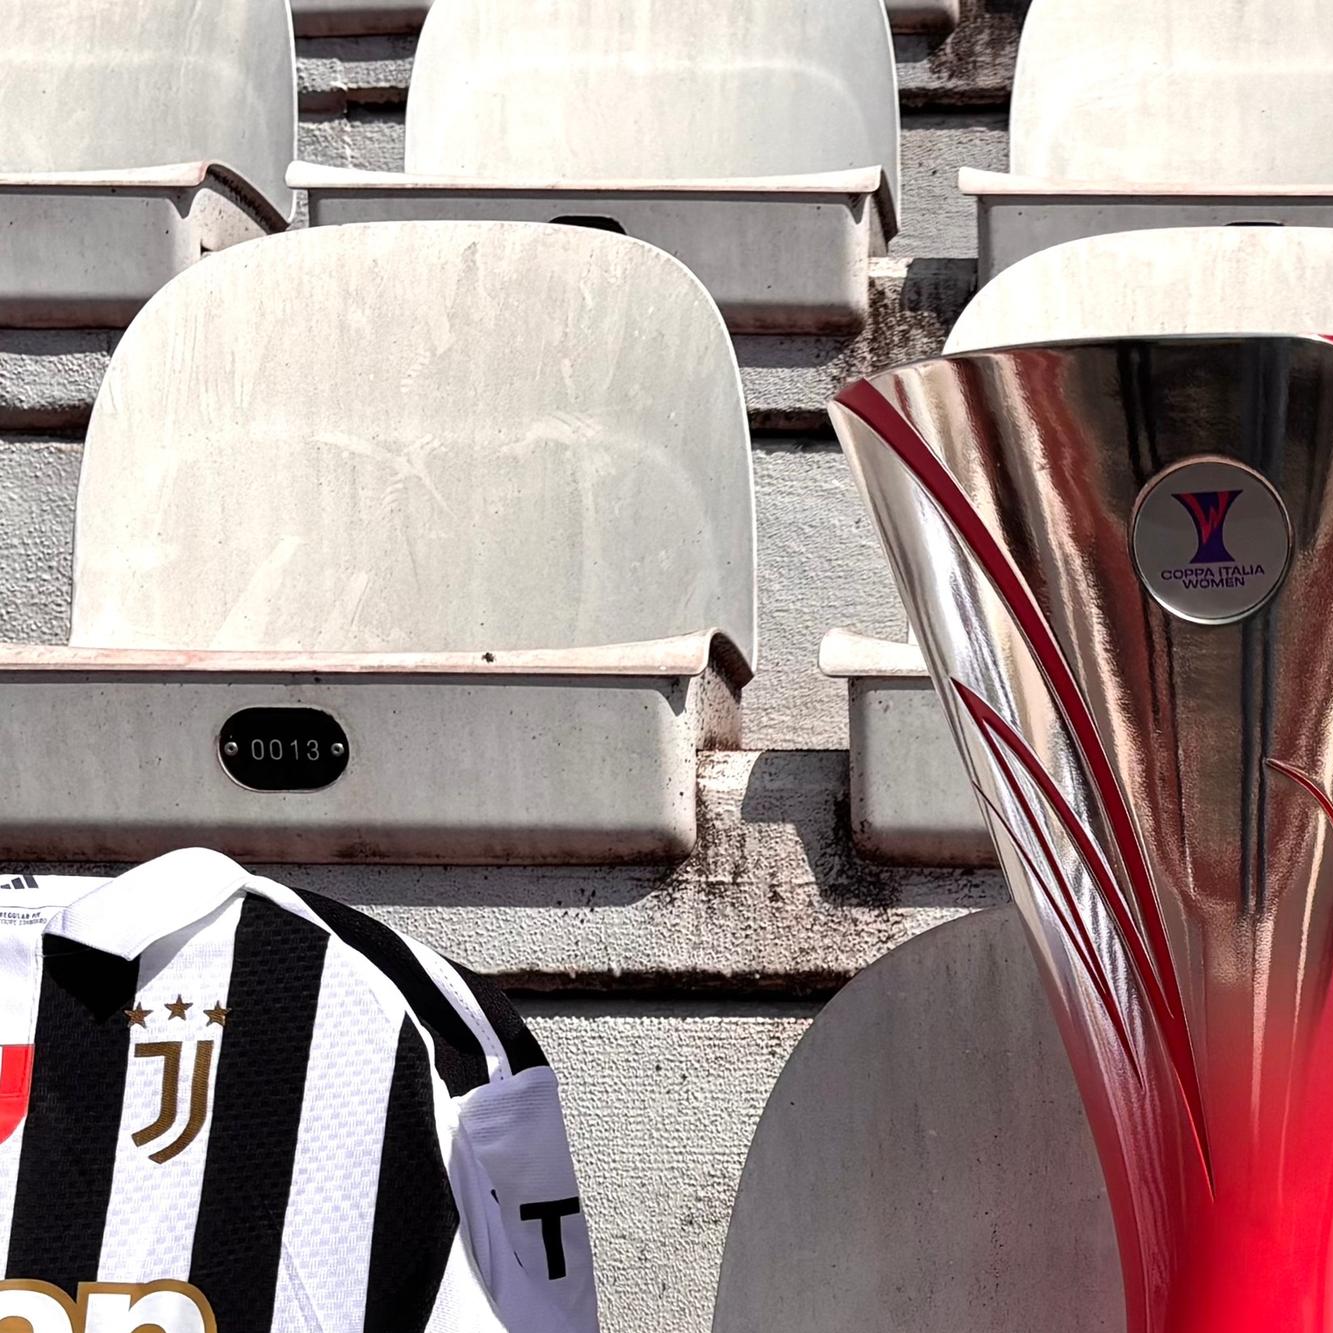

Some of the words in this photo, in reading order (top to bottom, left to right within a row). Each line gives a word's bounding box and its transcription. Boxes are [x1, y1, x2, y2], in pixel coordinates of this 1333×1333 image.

[1161, 568, 1214, 580] COPPA
[1219, 565, 1264, 577] ITALIA
[1182, 577, 1245, 589] WOMEN
[251, 739, 320, 760] 0013
[490, 1189, 580, 1281] T
